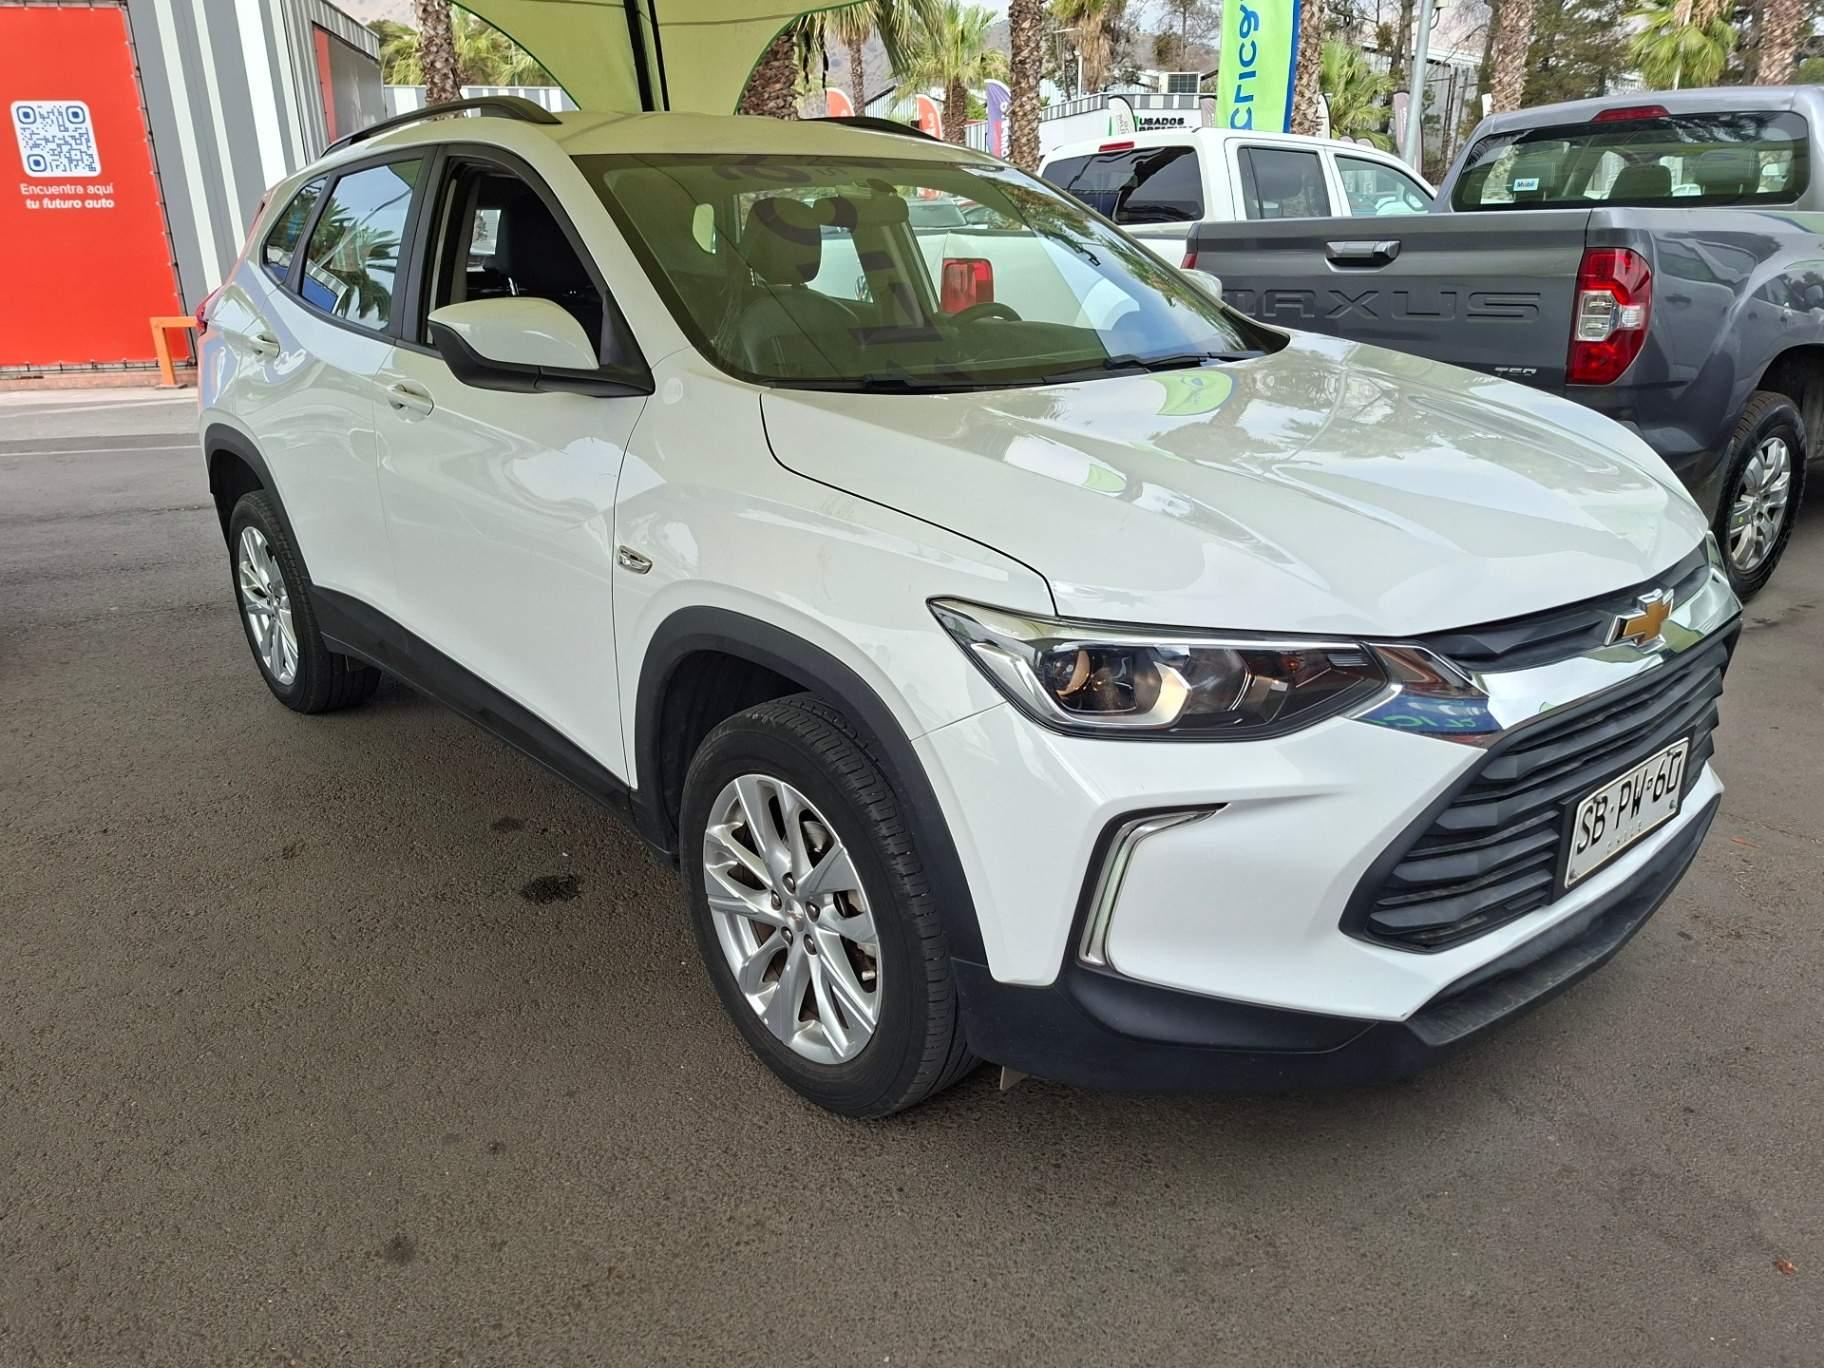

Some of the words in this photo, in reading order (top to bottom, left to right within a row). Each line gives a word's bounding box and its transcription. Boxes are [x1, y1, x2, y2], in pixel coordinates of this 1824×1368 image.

[1139, 117, 1185, 126] USADOS
[20, 183, 84, 195] Encuentra
[26, 199, 40, 209] tu
[42, 198, 82, 209] futuro
[84, 199, 115, 208] auto
